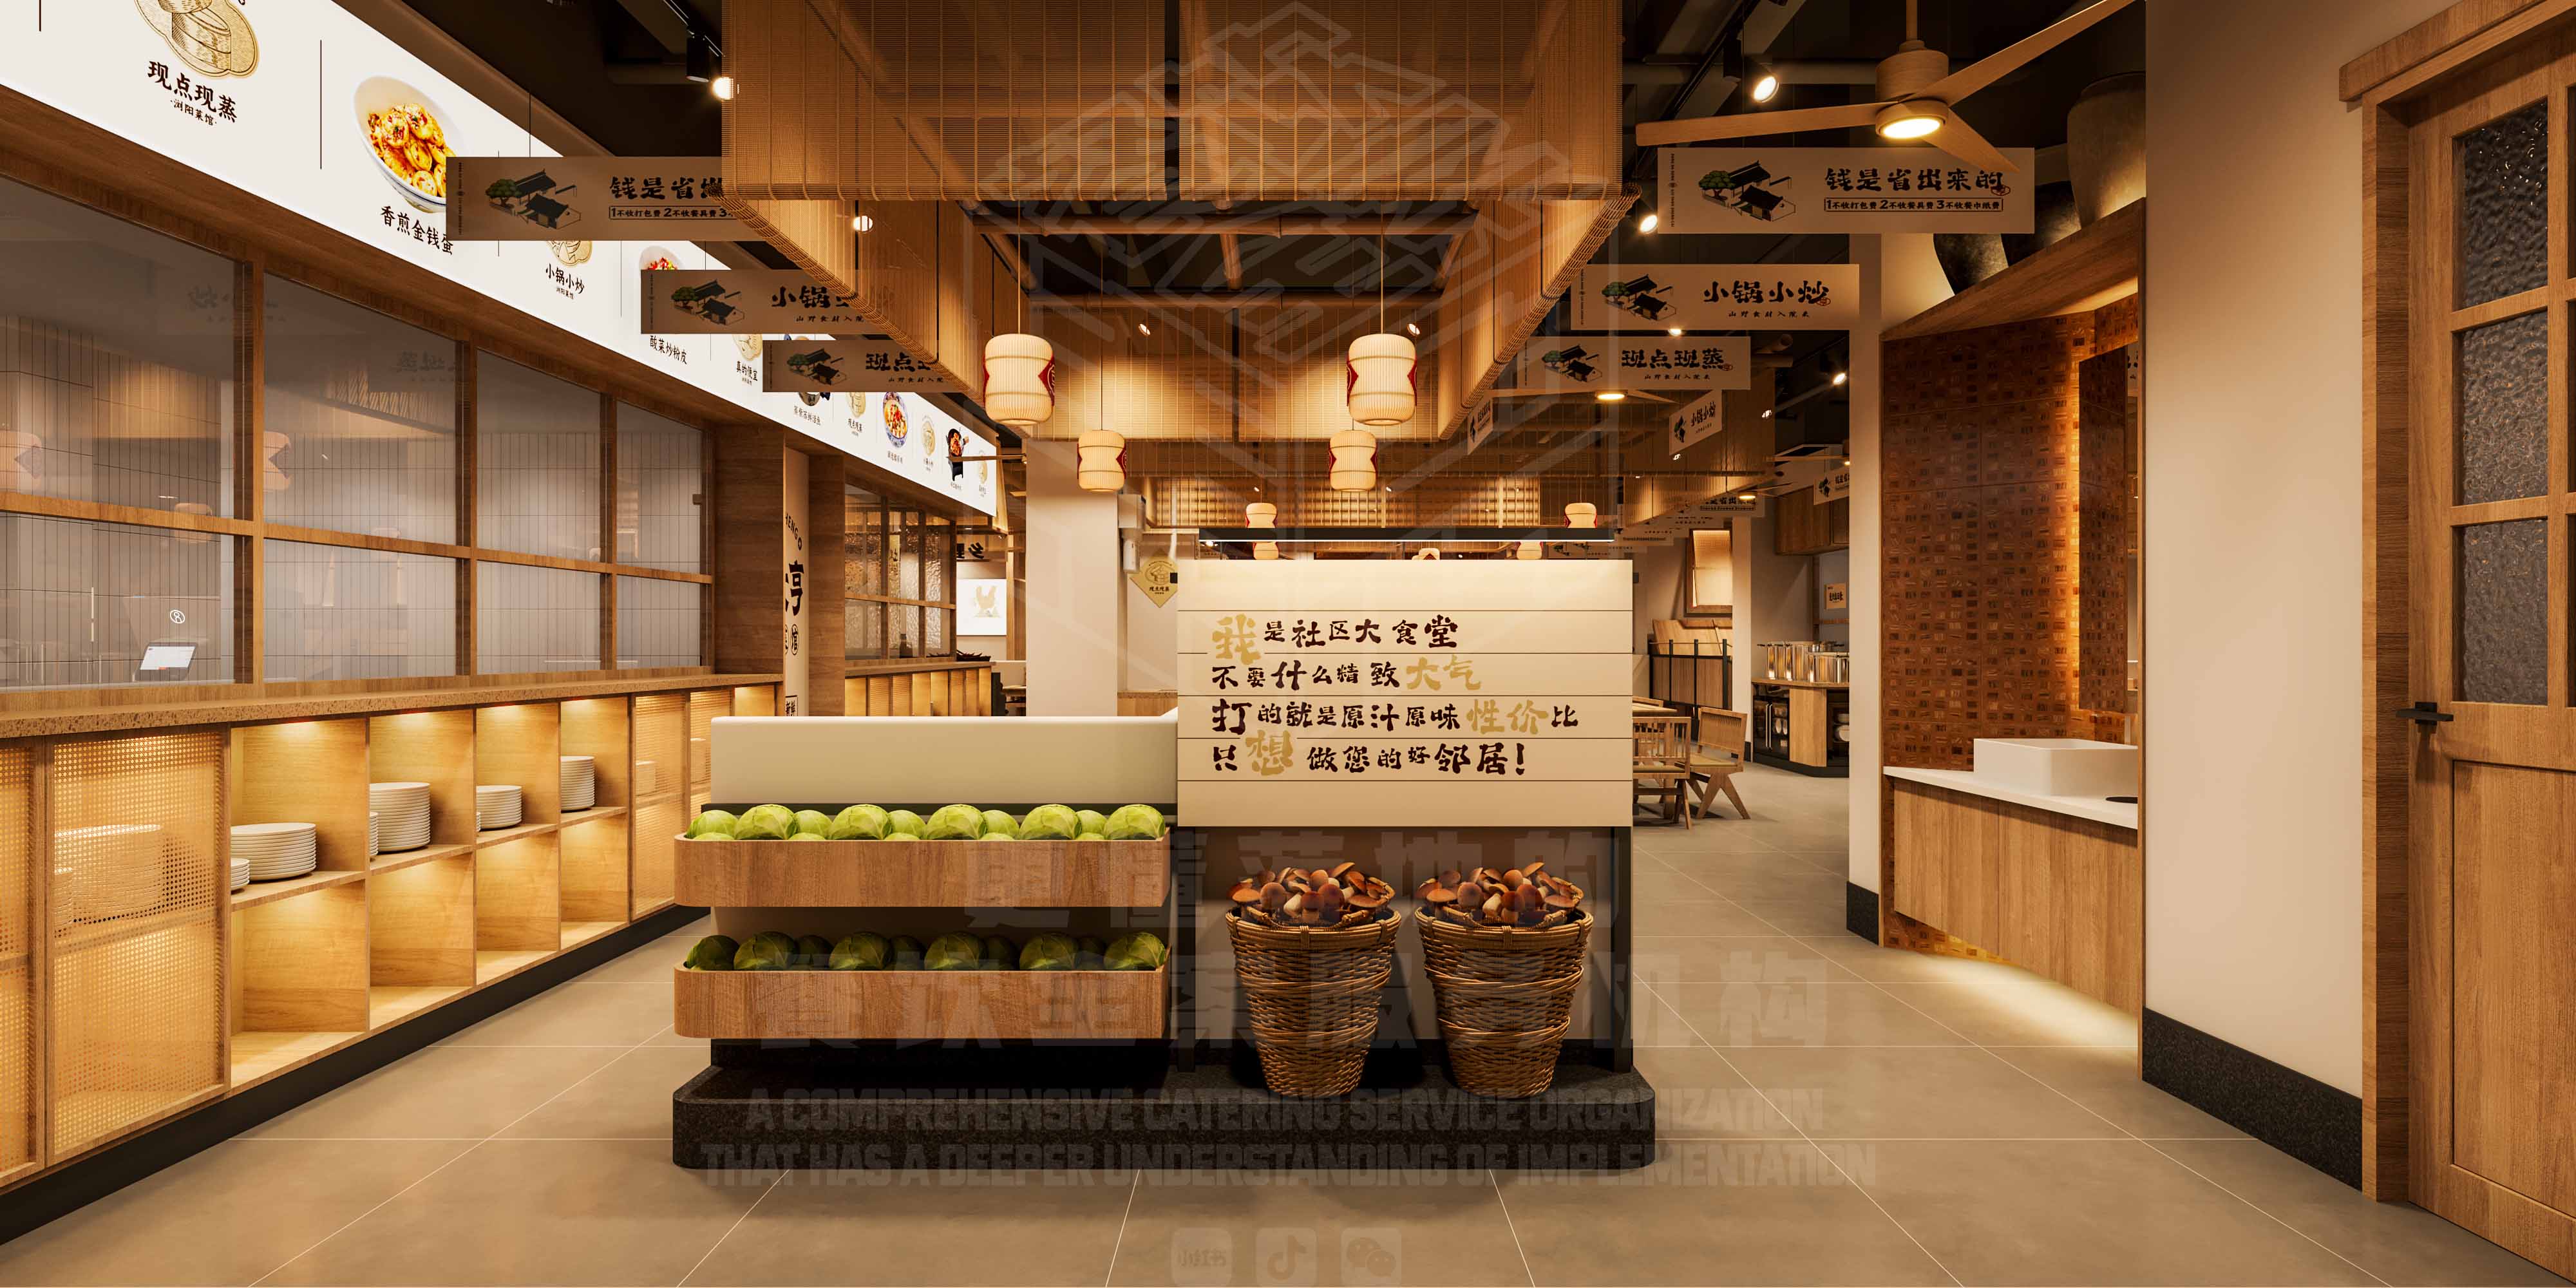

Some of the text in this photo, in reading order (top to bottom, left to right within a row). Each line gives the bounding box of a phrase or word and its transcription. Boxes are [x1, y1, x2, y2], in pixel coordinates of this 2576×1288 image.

[147, 61, 237, 123] 现点现蒸
[1825, 168, 2004, 191] 钱是省出来的
[611, 208, 661, 218] 1不收打包费
[663, 207, 716, 218] 2不收餐具费
[1826, 200, 2000, 209] 1不收打包费 2不收餐具费 3不收餐巾纸费
[381, 205, 453, 255] 香煎金钱蛋
[545, 263, 585, 294] 小锅小炒
[1704, 280, 1829, 304] 小锅小炒
[650, 335, 687, 364] 酸菜炒粉皮
[1622, 348, 1725, 369] 现点现蒸
[736, 361, 758, 381] 真的便宜
[1212, 614, 1459, 665] 我是社区大食堂
[1212, 654, 1481, 691] 不要什么精致大气
[1212, 699, 1578, 735] 打的就是原汁原味性价比
